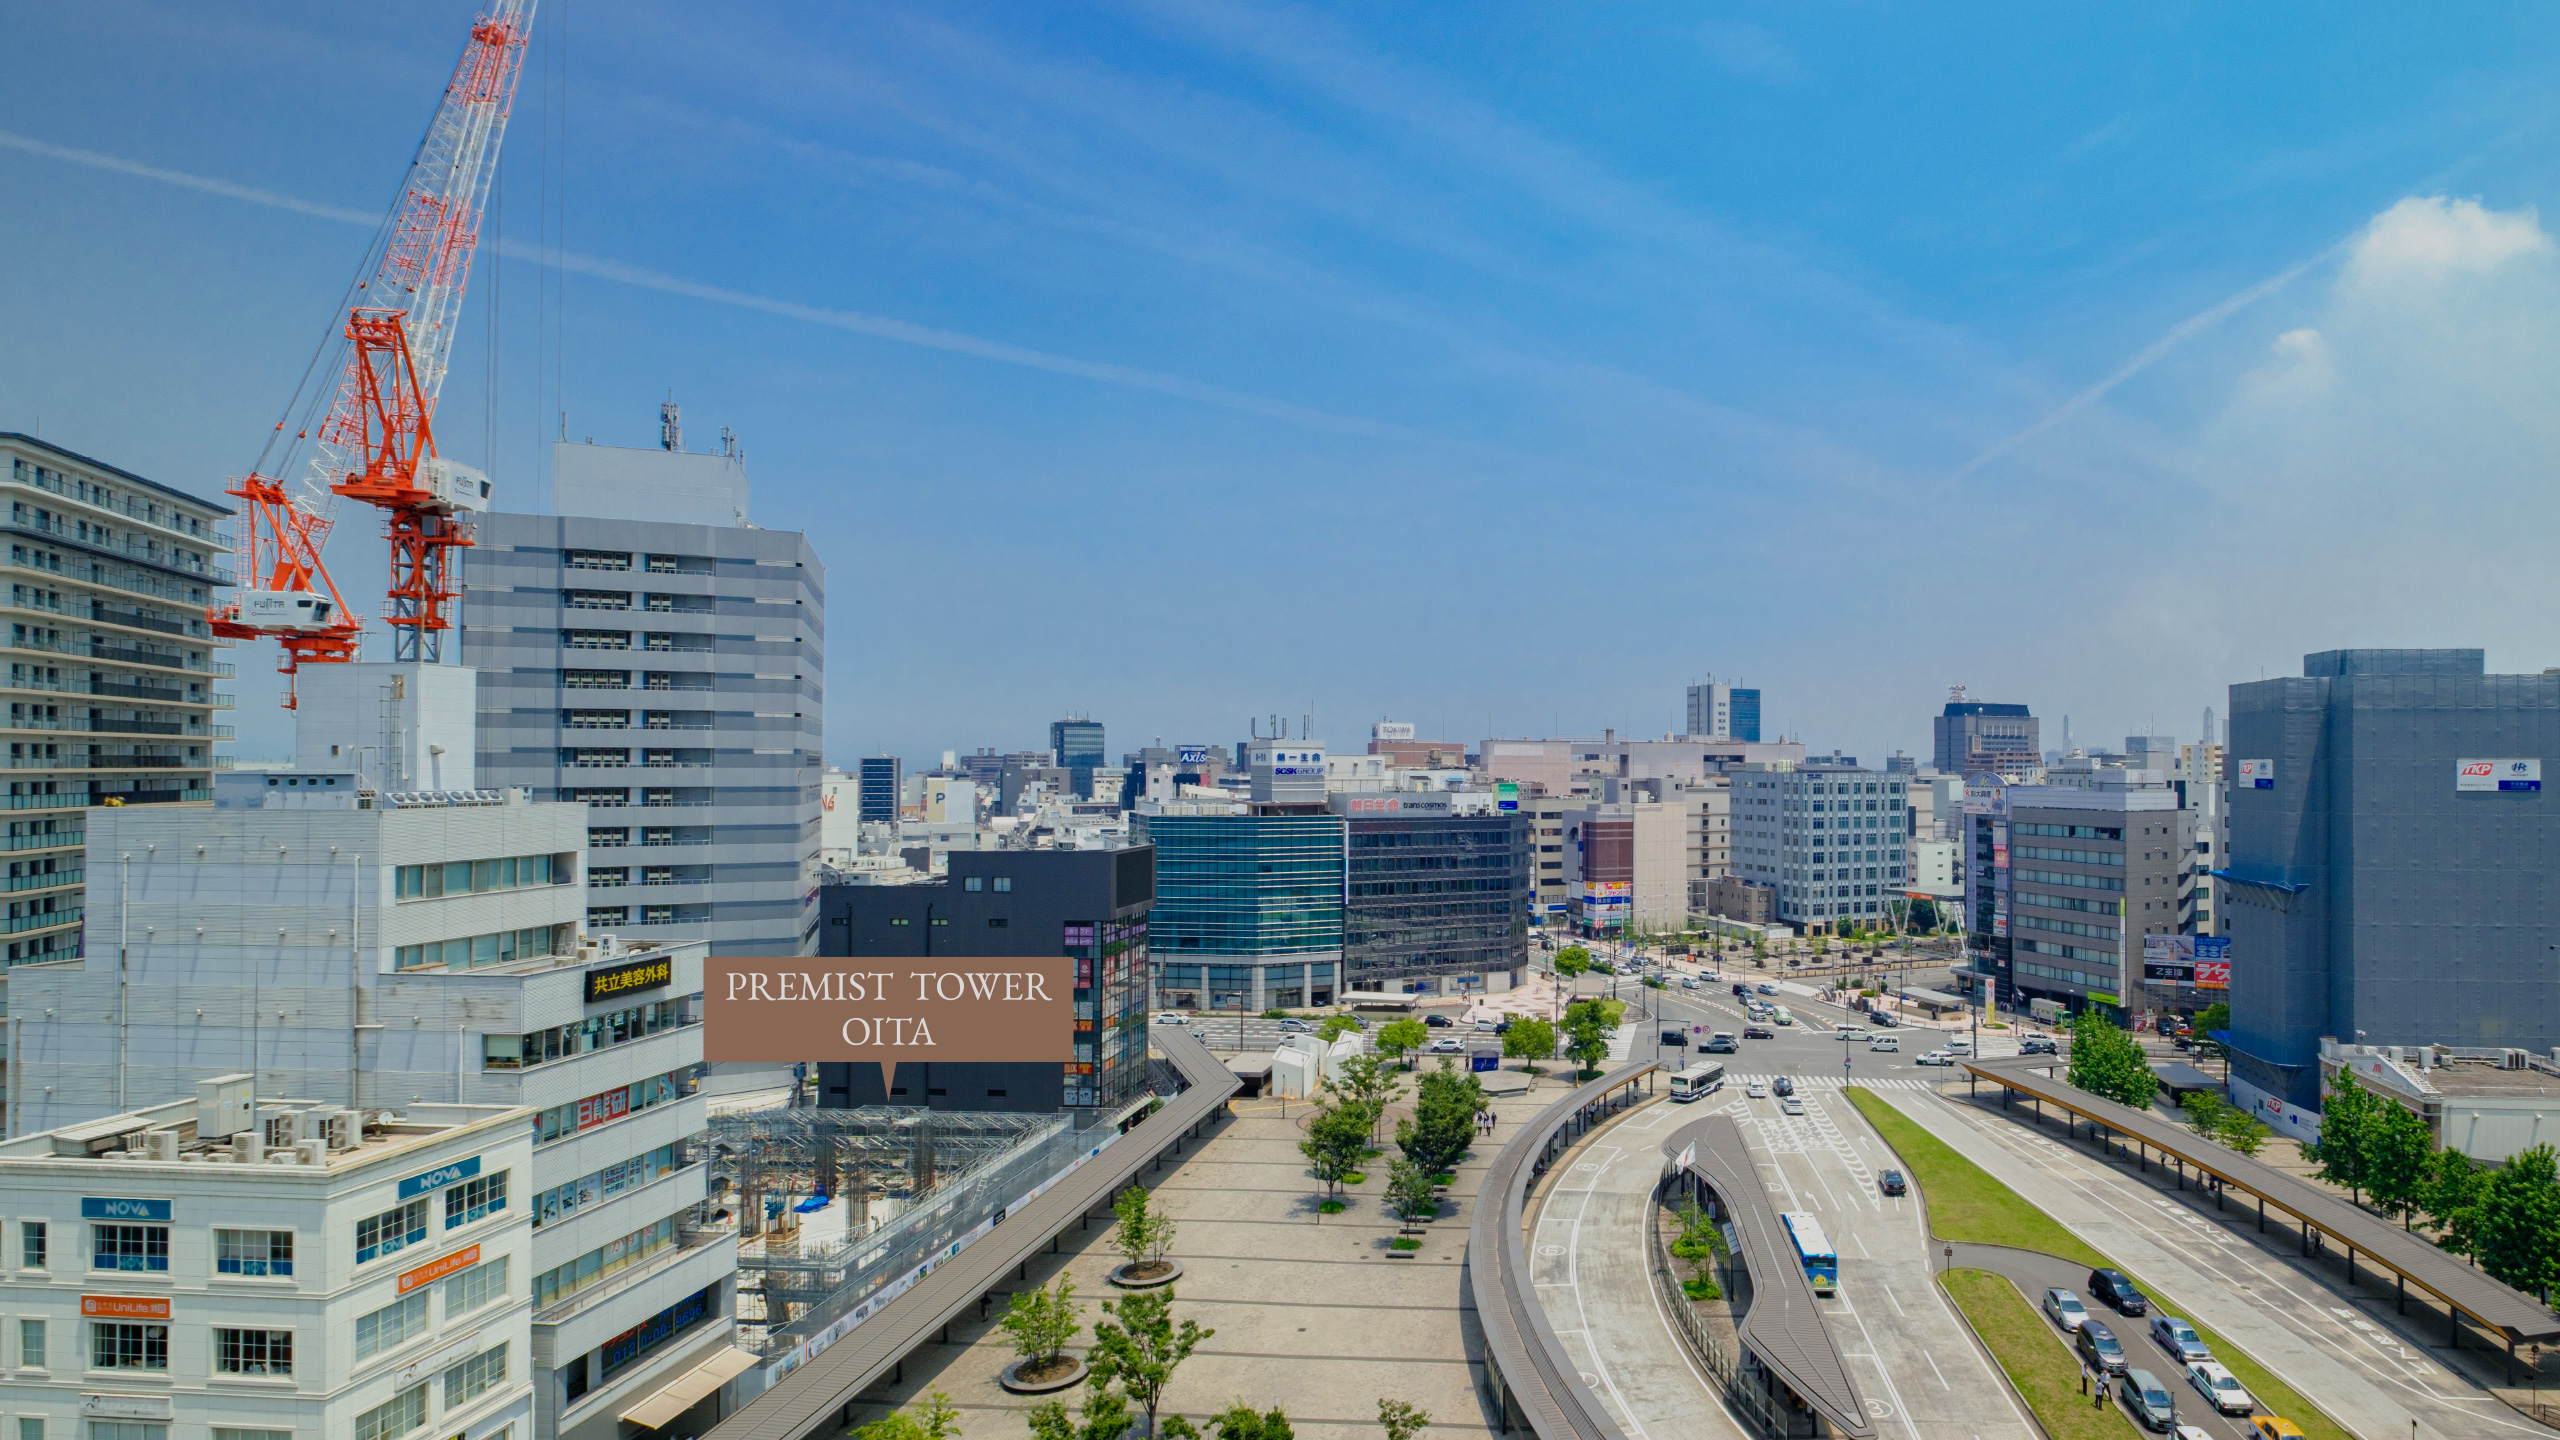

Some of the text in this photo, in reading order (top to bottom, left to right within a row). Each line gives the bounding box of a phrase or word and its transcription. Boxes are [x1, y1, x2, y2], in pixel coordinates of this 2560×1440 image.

[1382, 726, 1411, 734] TOKIWA
[1181, 752, 1206, 763] Axis
[2463, 764, 2493, 775] TKP
[936, 793, 945, 804] P
[1351, 798, 1399, 812] 朝日生命
[594, 963, 669, 995] 共立美容外科
[578, 1090, 627, 1125] 日能研
[421, 1166, 462, 1189] NOVA
[105, 1202, 150, 1216] NOVA
[429, 1257, 461, 1276] UniLife
[113, 1303, 148, 1313] UniLife
